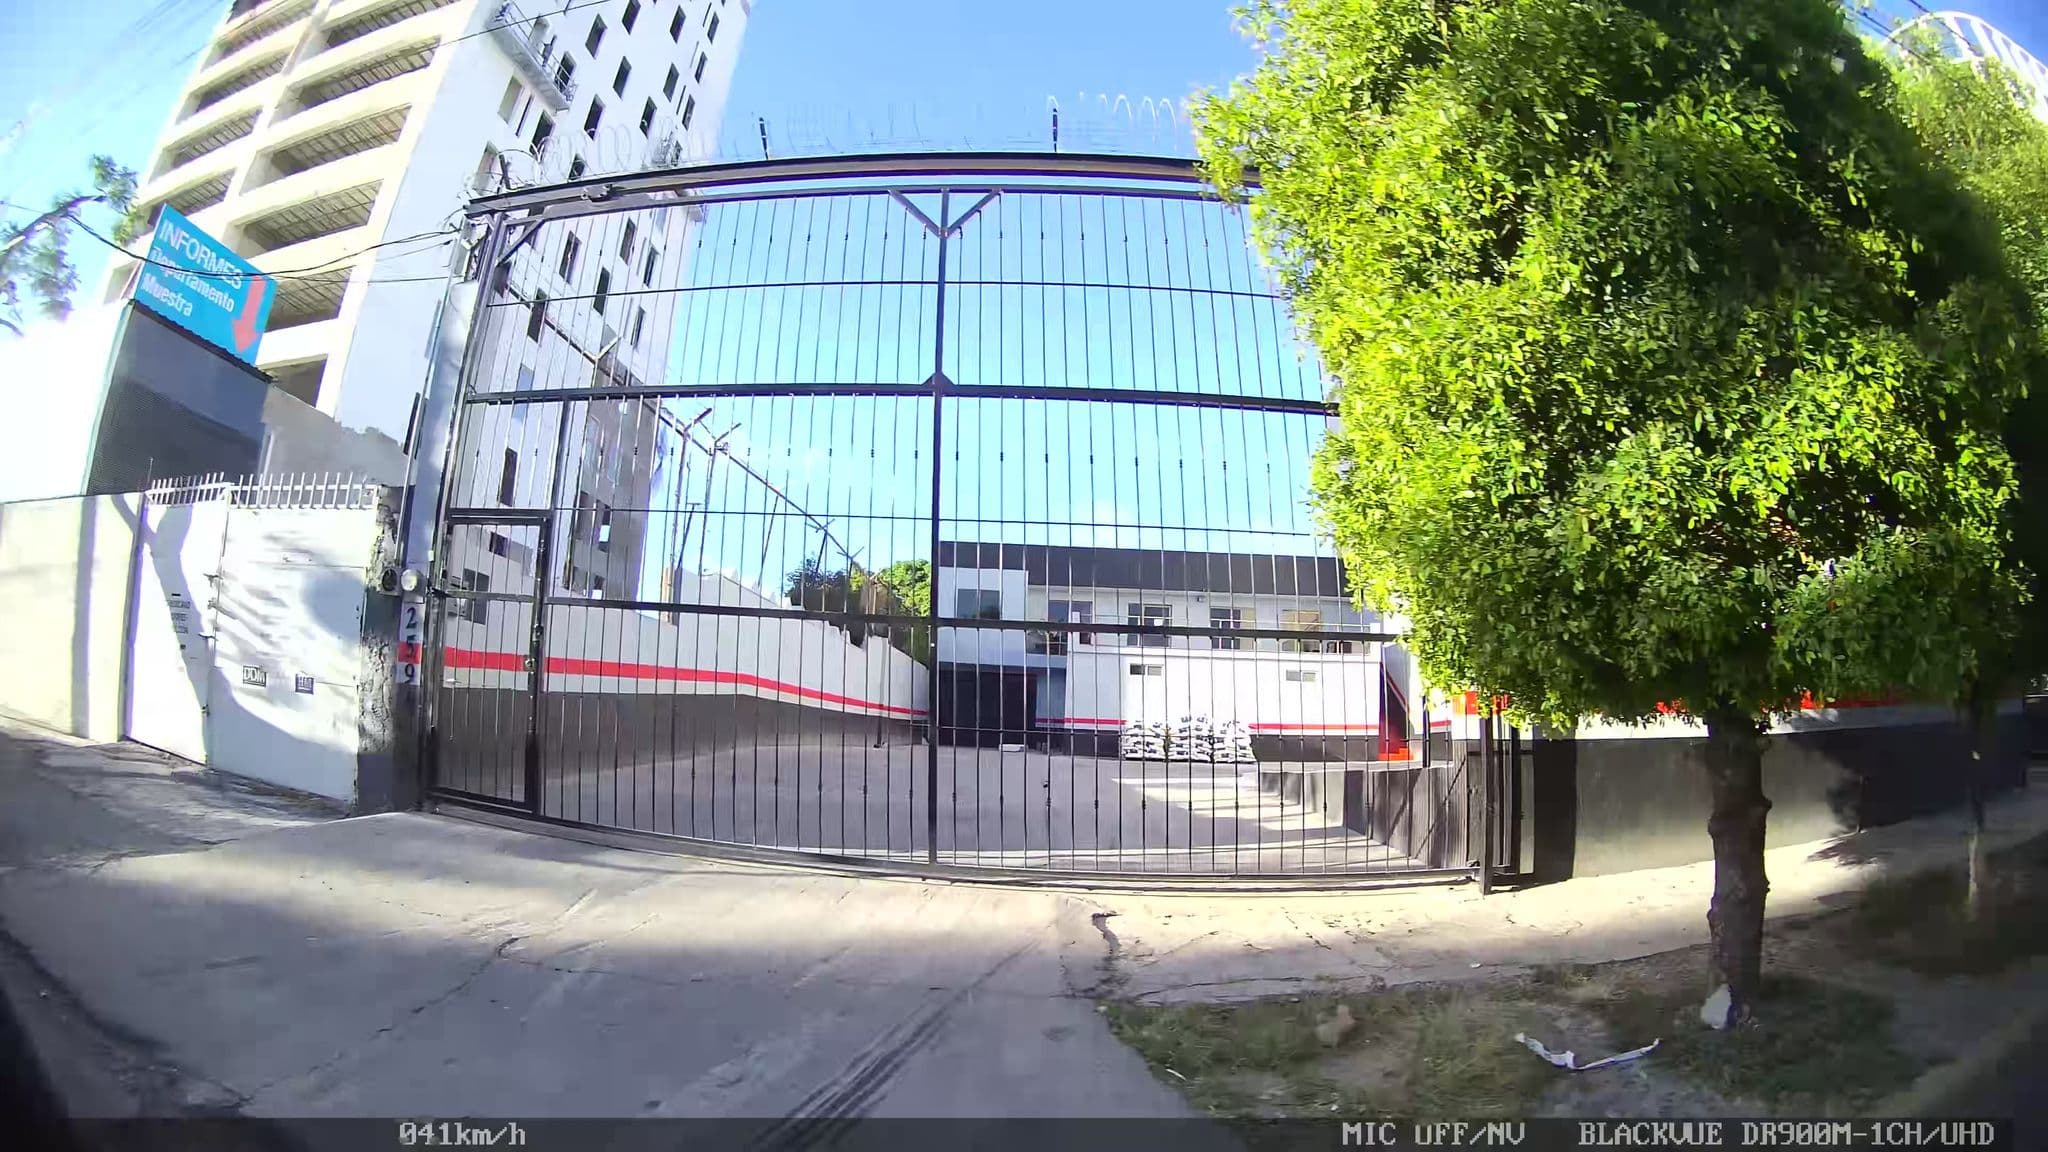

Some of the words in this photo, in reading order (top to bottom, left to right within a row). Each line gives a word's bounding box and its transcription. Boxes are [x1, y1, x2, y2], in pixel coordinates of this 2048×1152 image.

[150, 246, 235, 313] Departamento
[159, 219, 243, 290] INFORMES
[141, 273, 193, 317] Muestra
